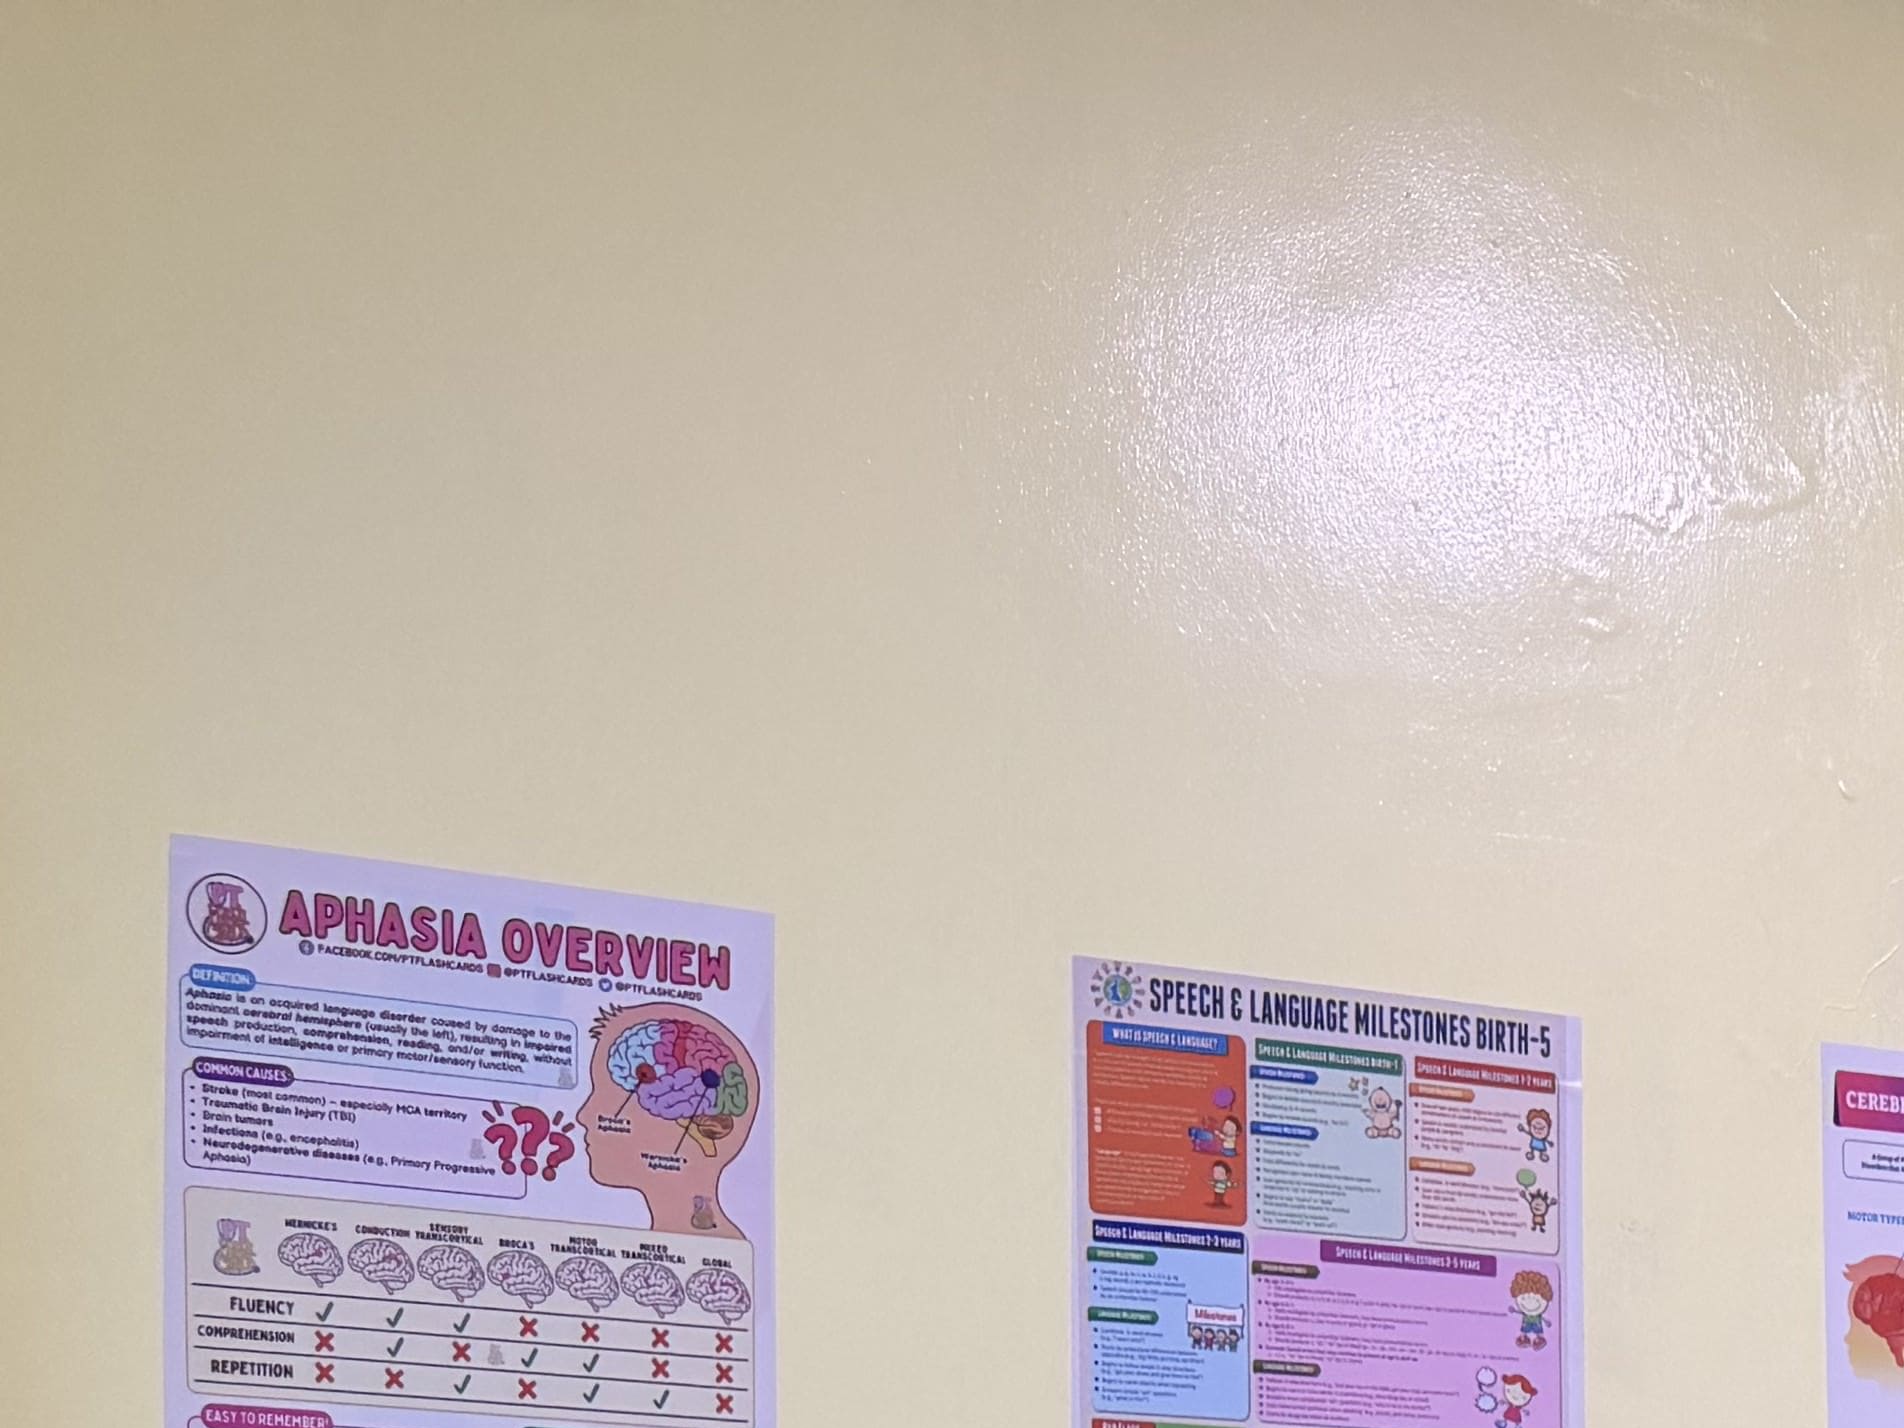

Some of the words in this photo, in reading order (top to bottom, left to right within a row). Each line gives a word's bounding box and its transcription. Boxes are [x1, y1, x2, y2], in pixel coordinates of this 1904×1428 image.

[279, 890, 487, 959] APHASIA
[501, 918, 730, 990] OVERVIEW
[504, 968, 593, 987] @PTFLASHCARDS
[616, 981, 702, 1001] @PTFLASHCARDS
[186, 987, 231, 1003] Aphasia
[236, 992, 245, 1002] is
[250, 995, 265, 1005] an
[270, 996, 319, 1012] acquired
[323, 1004, 375, 1019] language
[380, 1010, 426, 1024] disorder
[431, 1015, 471, 1029] caused
[475, 1019, 487, 1032] by
[492, 1024, 535, 1039] damage
[539, 1029, 550, 1039] to
[555, 1031, 572, 1042] the
[1150, 978, 1224, 1019] SPEECH
[1231, 988, 1243, 1021] &
[1250, 990, 1349, 1033] LANGUAGE
[1355, 1002, 1471, 1048] MILESTONES
[1476, 1017, 1551, 1058] BIRTH-5
[1112, 1028, 1132, 1040] WHAT
[1142, 1031, 1169, 1045] SPEECH
[1177, 1034, 1219, 1050] LANGUAGE?
[195, 1062, 243, 1080] COMMON
[1848, 1211, 1879, 1223] MOTOR
[702, 1258, 732, 1269] GLOBAL
[230, 1297, 294, 1316] FLUENCY
[197, 1324, 295, 1344] COMPREHENSION
[211, 1359, 294, 1378] REPETITION
[206, 1409, 239, 1423] EASY
[241, 1411, 255, 1424] TO
[258, 1413, 329, 1428] REMEMBER!
